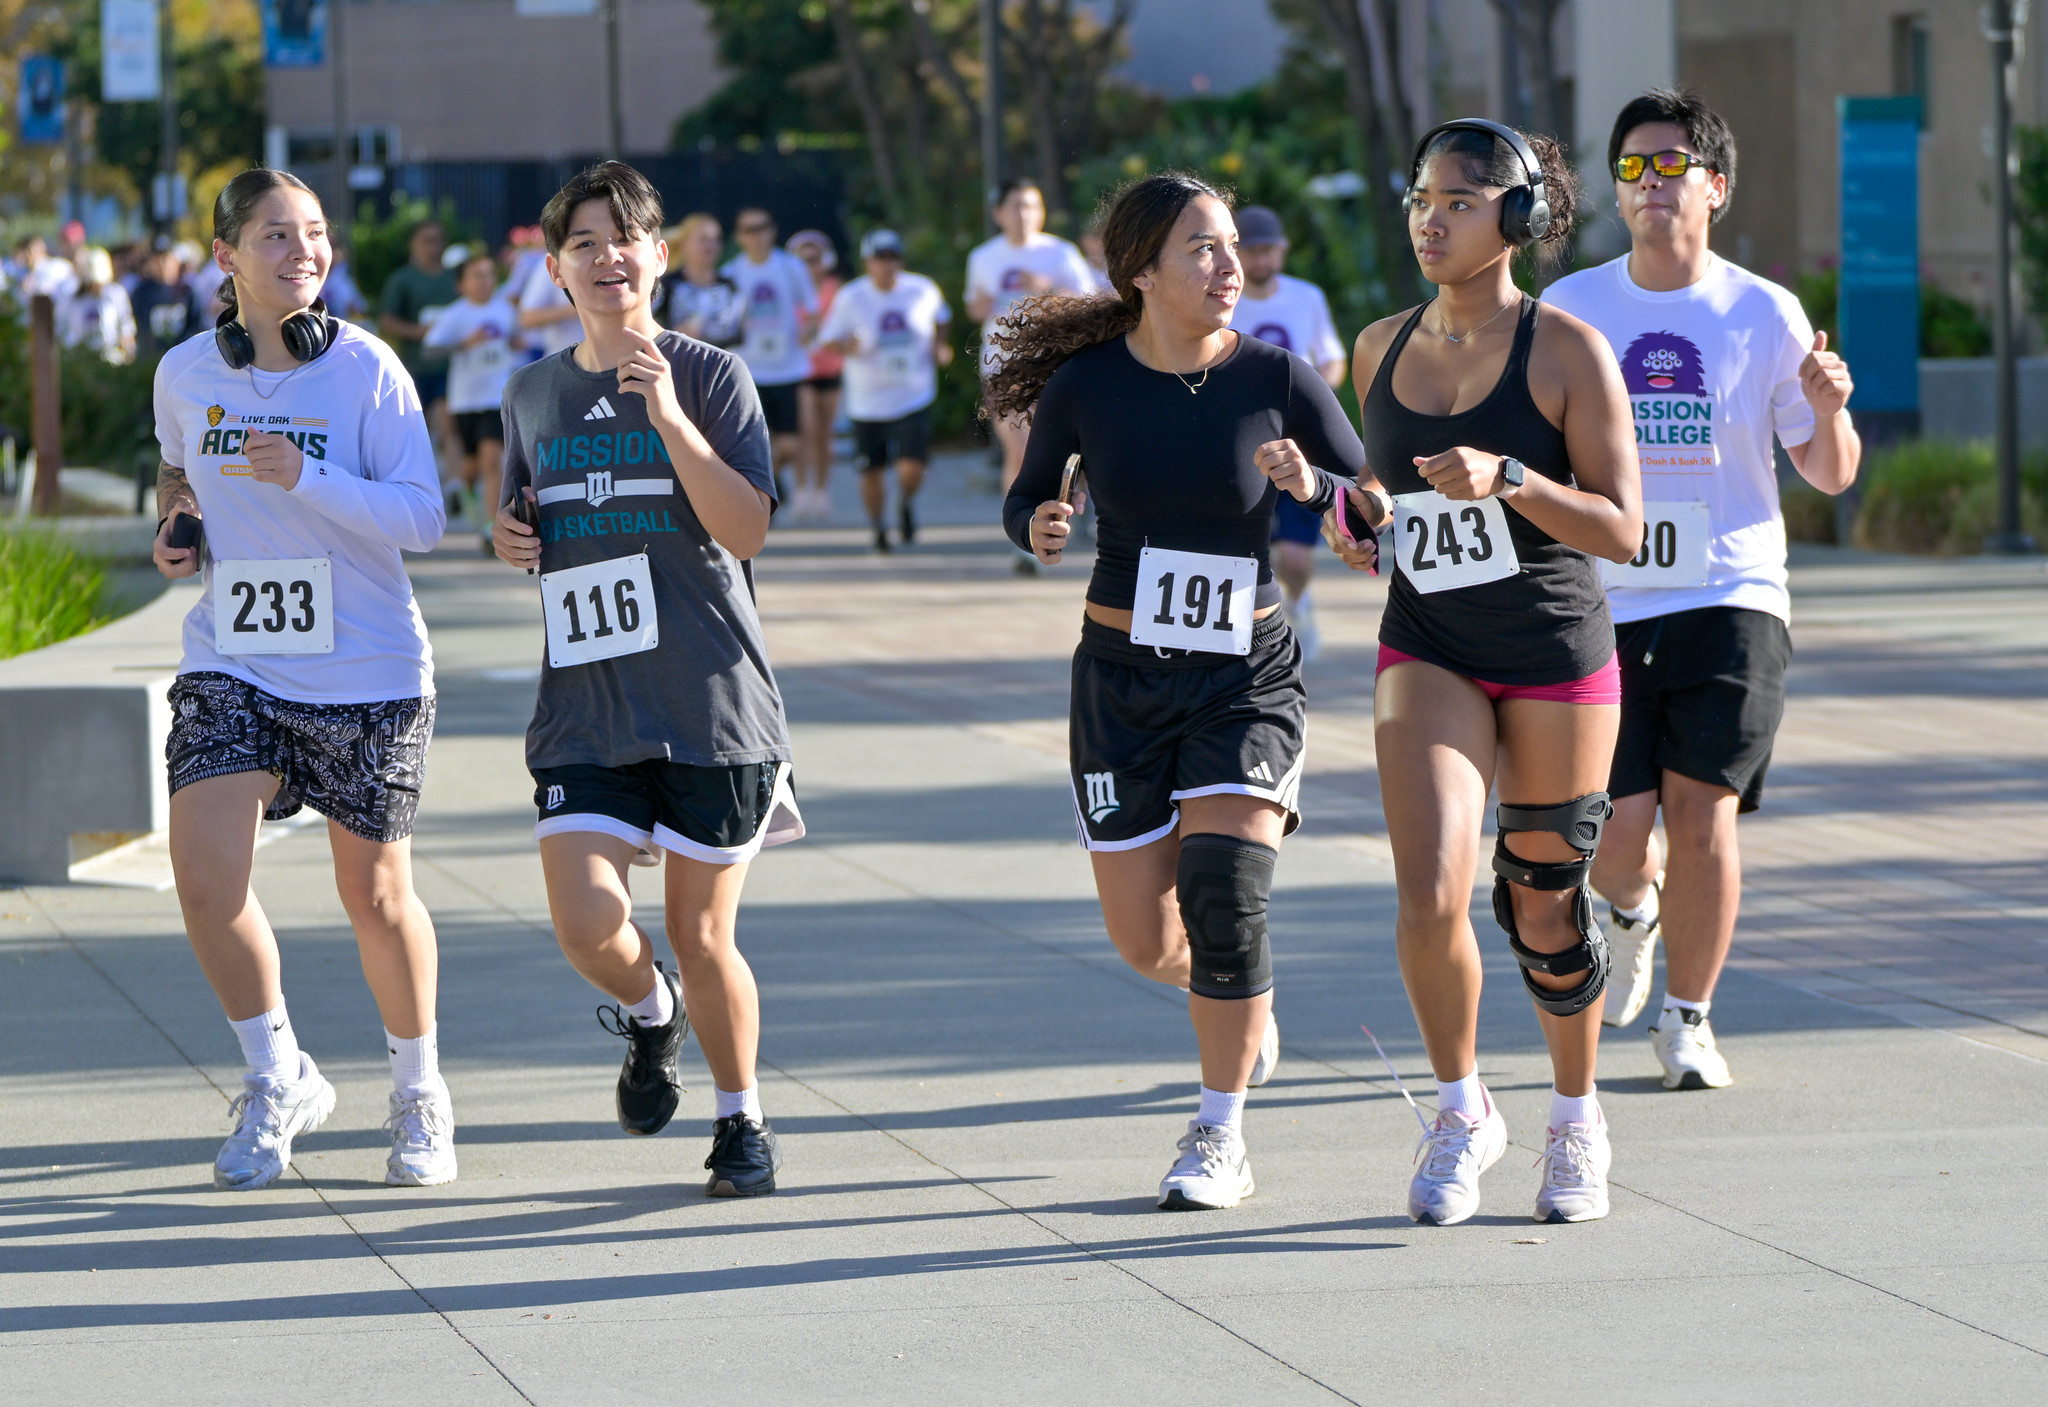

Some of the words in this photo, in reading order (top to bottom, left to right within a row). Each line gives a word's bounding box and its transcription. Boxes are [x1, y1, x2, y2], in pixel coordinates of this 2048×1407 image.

[241, 415, 266, 424] LIVE
[268, 416, 290, 425] OAK
[1631, 401, 1712, 421] ISSION
[537, 430, 672, 476] MISSION
[1634, 425, 1711, 445] LLEGE
[1646, 456, 1667, 465] Dash
[1670, 457, 1677, 465] &
[1679, 456, 1698, 465] Bash
[1700, 457, 1712, 465] 5K
[541, 510, 679, 543] BASKETBALL
[1406, 506, 1493, 572] 243
[231, 580, 316, 633] 233
[562, 578, 640, 643] 116
[1153, 572, 1234, 632] 191
